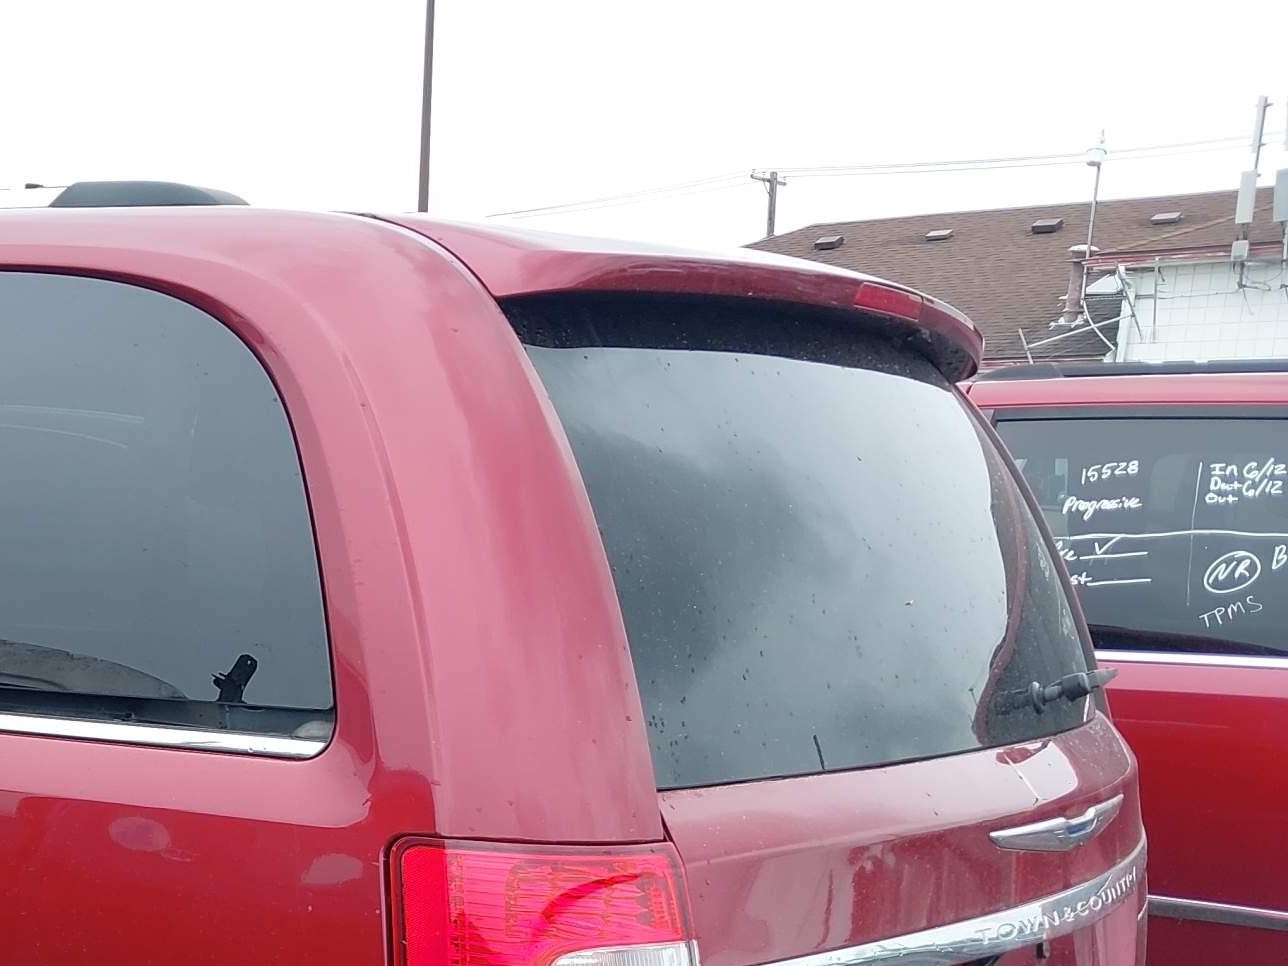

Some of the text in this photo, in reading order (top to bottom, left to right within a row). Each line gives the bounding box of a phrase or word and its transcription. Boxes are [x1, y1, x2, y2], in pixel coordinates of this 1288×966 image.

[1081, 460, 1139, 485] 15528
[1210, 457, 1287, 482] In 6/12
[1242, 478, 1283, 497] 6/12
[1198, 595, 1263, 628] TPMS
[975, 910, 1060, 945] TOWN
